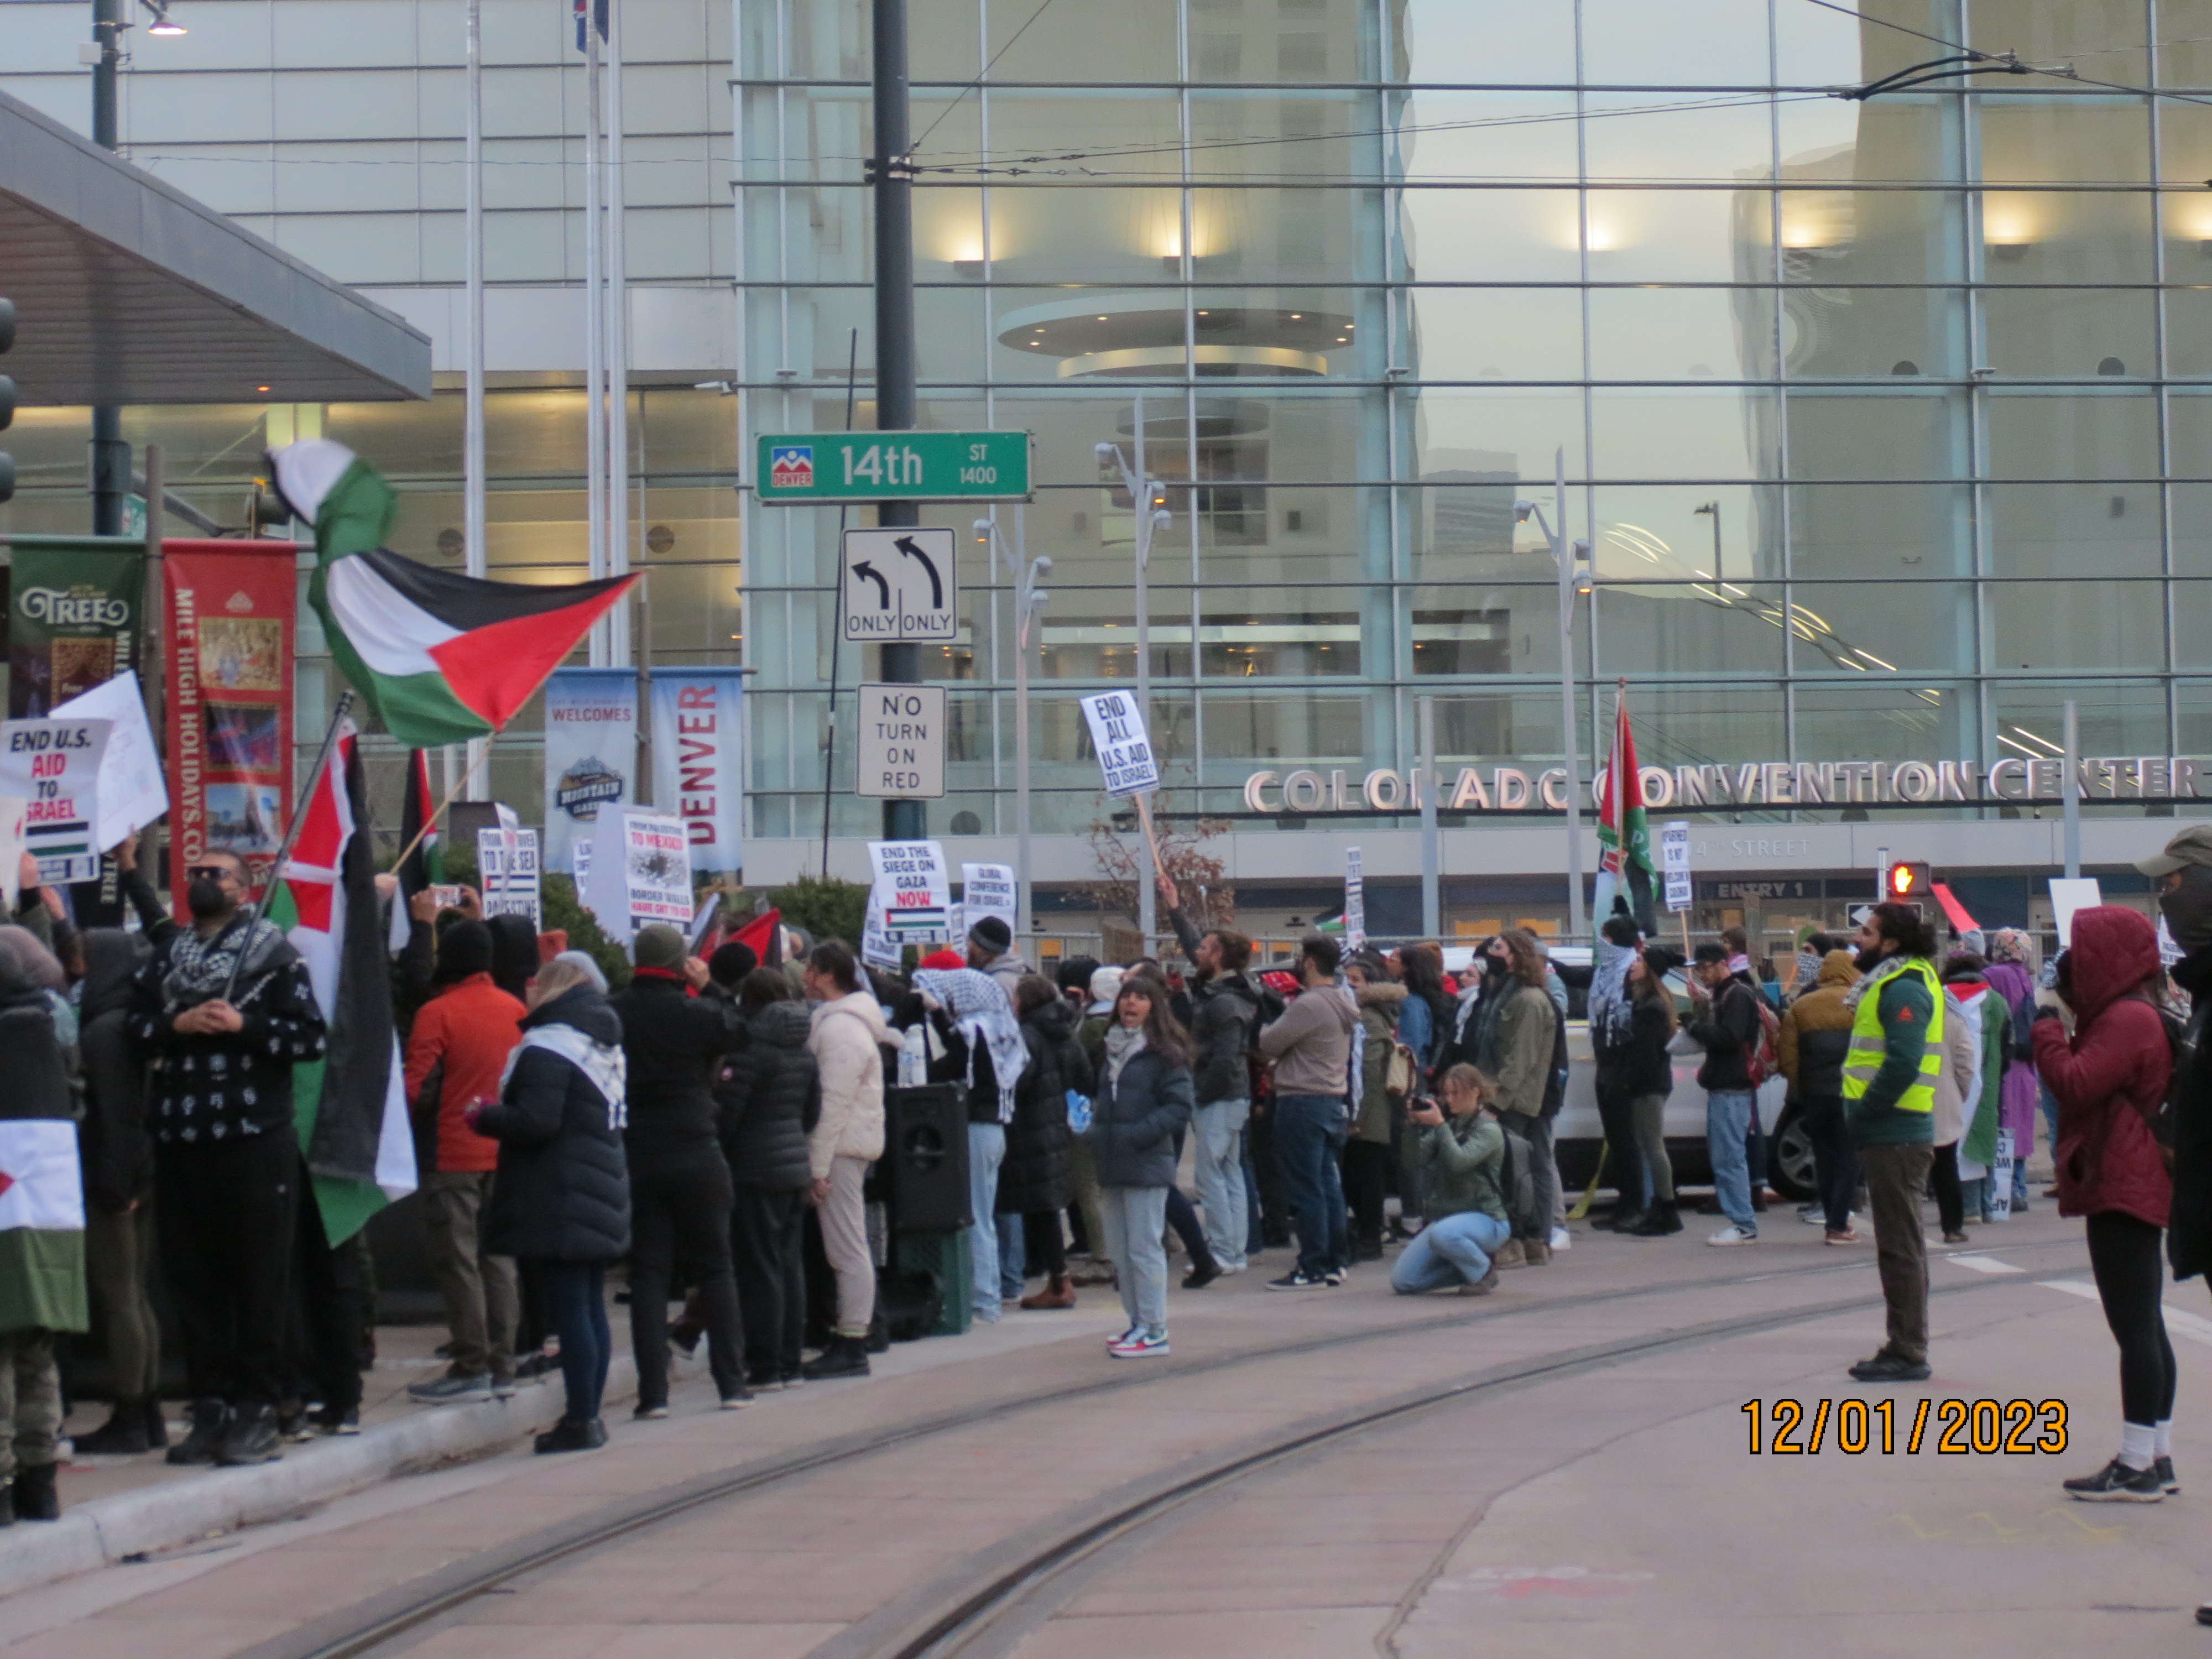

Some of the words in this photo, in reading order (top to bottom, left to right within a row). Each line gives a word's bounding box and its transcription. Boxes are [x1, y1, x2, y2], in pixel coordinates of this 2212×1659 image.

[969, 444, 987, 460] ST
[841, 445, 922, 485] 14th
[773, 473, 812, 486] DENVER
[959, 467, 996, 484] 1400
[19, 586, 129, 627] TREE
[175, 588, 195, 640] MILE
[848, 615, 896, 633] ONLY
[903, 614, 951, 632] ONLY
[176, 646, 197, 705] HIGH
[552, 707, 632, 722] WELCOMES
[882, 695, 922, 716] NO
[1094, 696, 1126, 719] END
[9, 731, 51, 753] END
[55, 728, 91, 749] U.S.
[876, 723, 926, 740] TURN
[1107, 719, 1132, 744] ALL
[677, 685, 717, 845] DENVER
[886, 748, 915, 764] ON
[1101, 748, 1128, 770] U.S.
[1129, 743, 1149, 764] AID
[32, 753, 66, 778] AID
[882, 772, 919, 789] RED
[1990, 757, 2200, 801] CENTER
[37, 780, 58, 798] TO
[27, 799, 76, 822] SRAEL
[880, 847, 905, 859] END
[907, 846, 931, 858] THE
[1732, 839, 1811, 857] STREET
[883, 859, 917, 874] SIEGE
[918, 859, 936, 872] ON
[896, 876, 927, 889] GAZA
[1718, 882, 1786, 898] ENTRY
[895, 891, 931, 907] NOW
